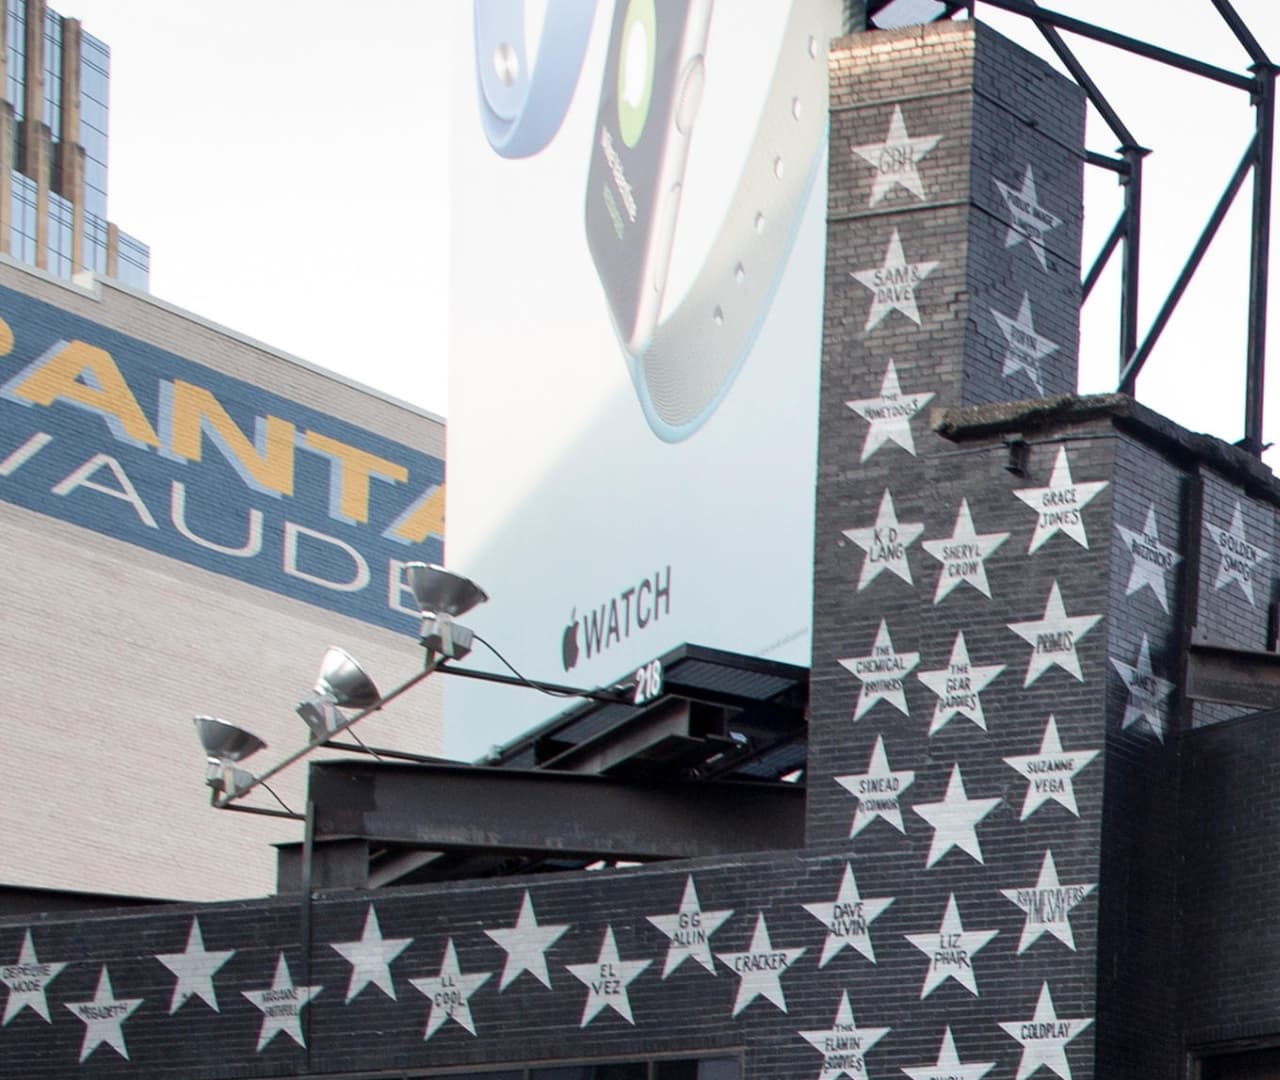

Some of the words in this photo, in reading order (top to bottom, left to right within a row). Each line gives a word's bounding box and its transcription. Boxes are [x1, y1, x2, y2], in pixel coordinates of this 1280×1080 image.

[876, 284, 912, 304] DAVE
[1042, 489, 1079, 507] GRACE
[1041, 508, 1081, 529] JONES
[870, 543, 906, 562] LANG
[942, 543, 983, 561] SHERYL
[1218, 531, 1258, 562] GOLDEN
[948, 560, 980, 578] CROW
[584, 564, 671, 660] WATCH
[856, 657, 906, 675] CHEMICAL
[950, 664, 970, 677] THE
[946, 677, 972, 693] GEAR
[1026, 760, 1077, 775] SUZANNE
[859, 778, 900, 795] SINEAD
[1034, 780, 1065, 795] VEGA
[833, 902, 865, 920] DAVE
[830, 919, 868, 938] ALVIN
[672, 930, 707, 947] ALLIN
[940, 934, 964, 951] LIZ
[600, 962, 616, 978] EL
[735, 953, 788, 972] CRACKER
[934, 952, 973, 971] PHAIR
[441, 976, 457, 988] LL
[590, 979, 621, 997] VEZ
[433, 991, 466, 1008] COOL
[1020, 1022, 1071, 1041] COLDPLAY
